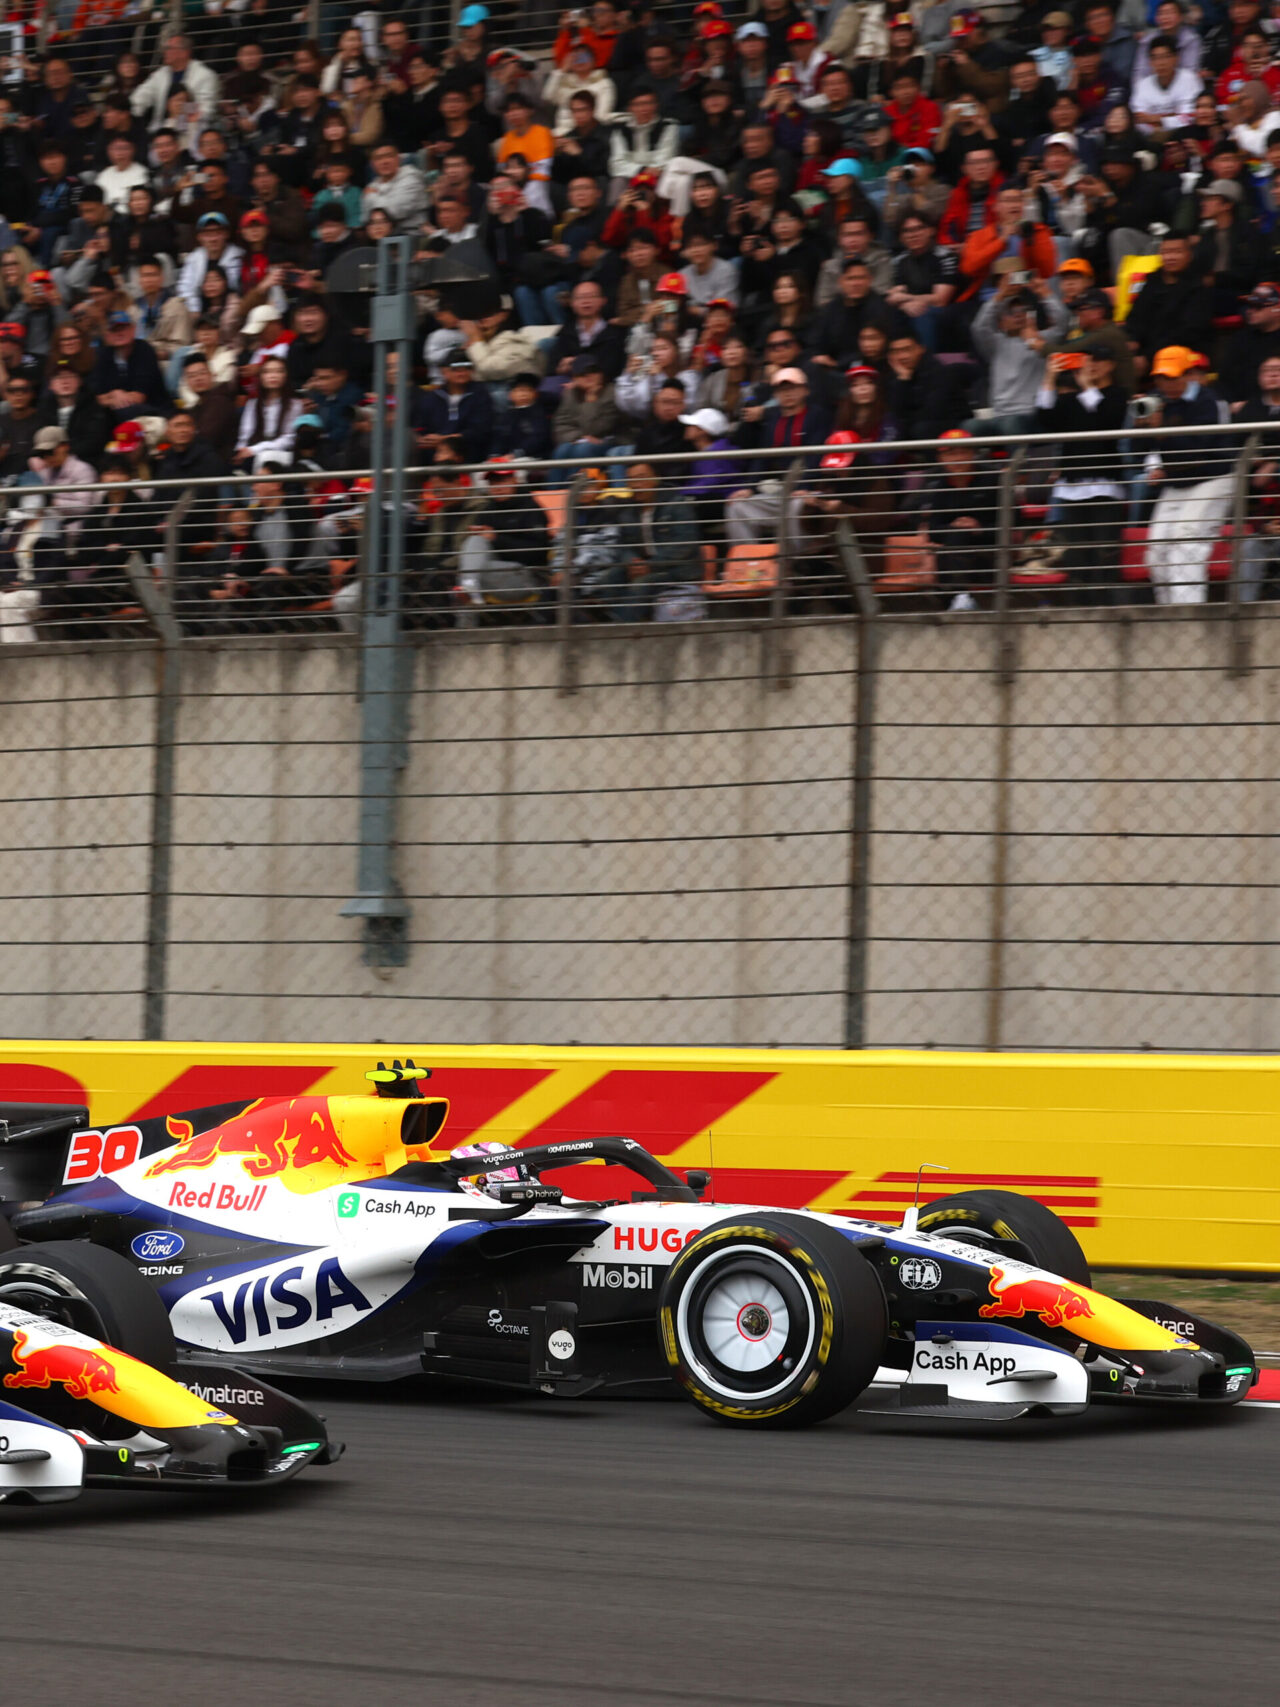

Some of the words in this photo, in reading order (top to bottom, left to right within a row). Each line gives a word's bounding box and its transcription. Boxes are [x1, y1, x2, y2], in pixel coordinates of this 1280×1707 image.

[65, 1128, 141, 1184] 30
[483, 1151, 524, 1165] yugo.com
[169, 1181, 216, 1208] Red
[216, 1184, 267, 1212] Bull
[365, 1198, 401, 1214] Cash
[404, 1199, 436, 1217] App
[140, 1233, 176, 1257] Ford
[138, 1265, 184, 1276] ACING
[582, 1263, 652, 1290] Mobil
[201, 1256, 374, 1345] VISA
[495, 1324, 530, 1336] OCTAVE
[1151, 1316, 1195, 1336] trace
[551, 1341, 572, 1352] yugo
[916, 1349, 968, 1371] Cash
[972, 1351, 1017, 1375] App
[189, 1382, 264, 1405] dynatrace
